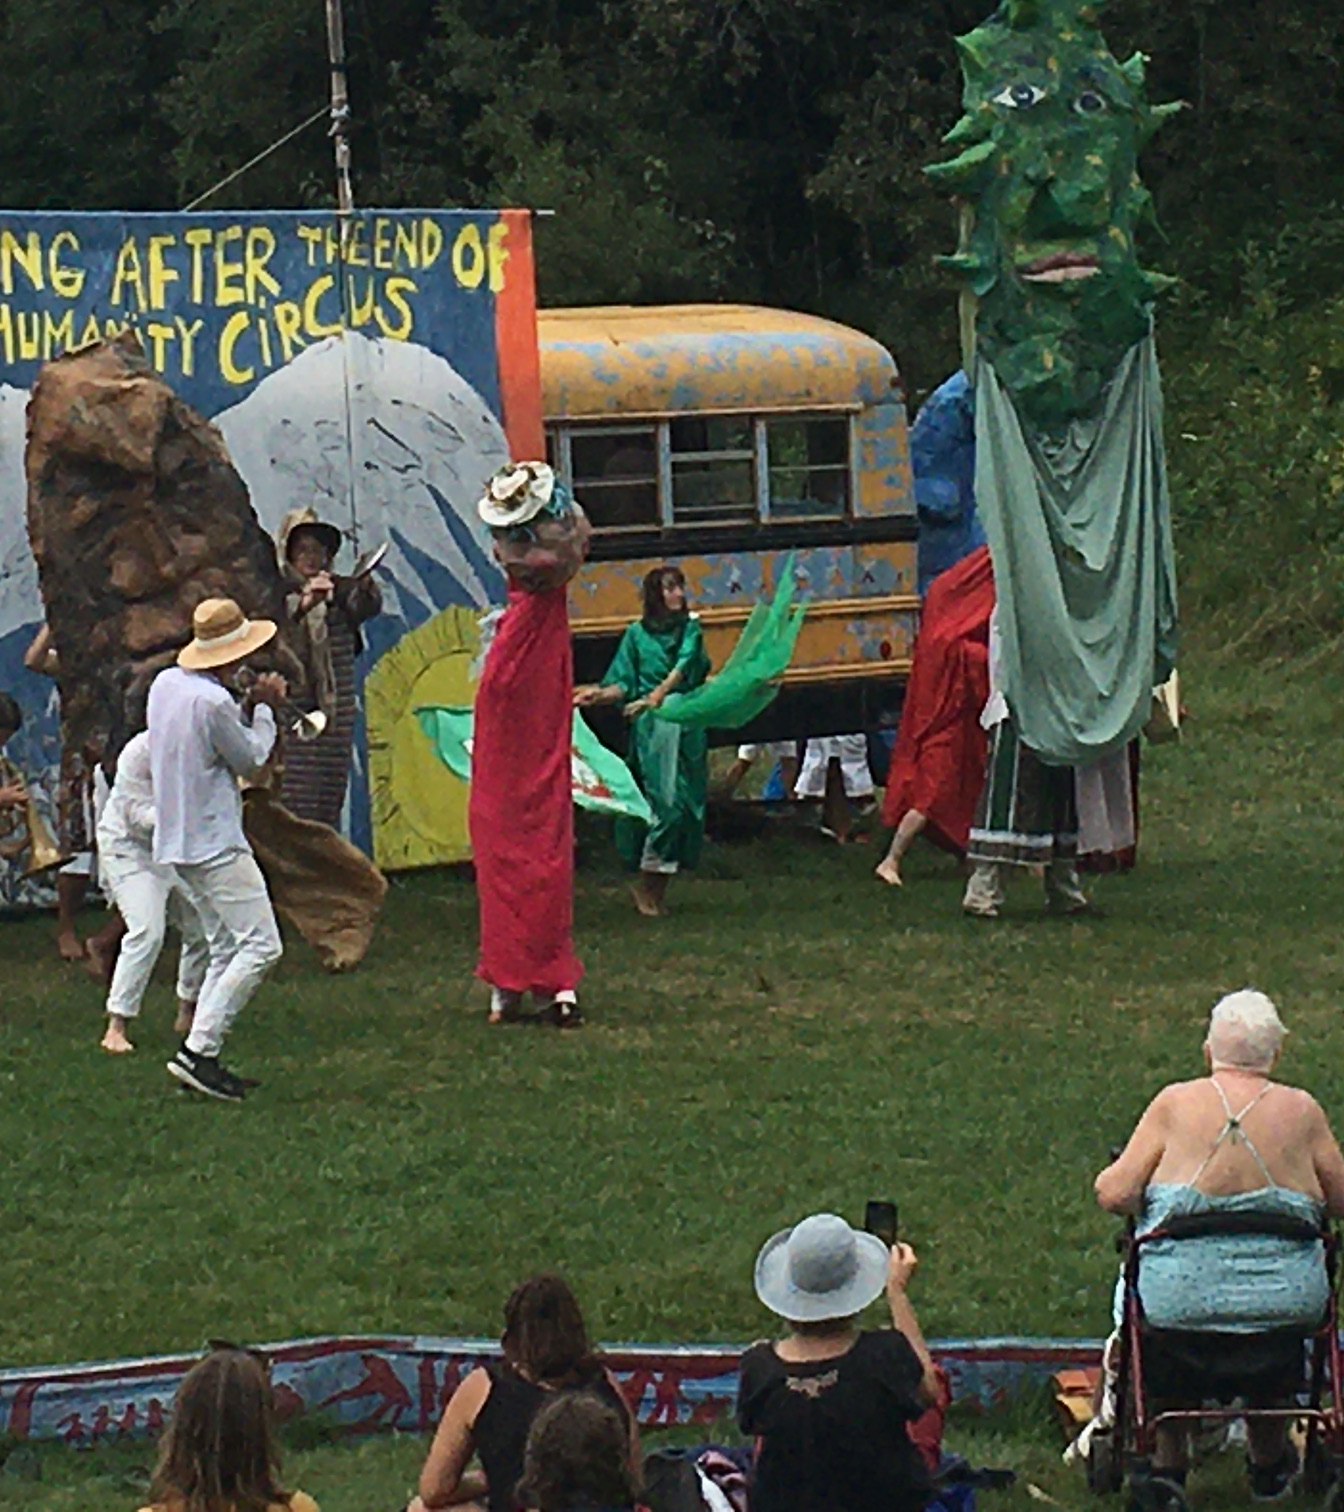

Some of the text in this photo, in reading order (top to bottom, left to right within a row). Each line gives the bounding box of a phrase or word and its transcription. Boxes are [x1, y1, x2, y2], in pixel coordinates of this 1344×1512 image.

[110, 224, 282, 314] AFTER
[297, 221, 372, 267] THE
[374, 217, 442, 270] END
[451, 222, 511, 293] OF
